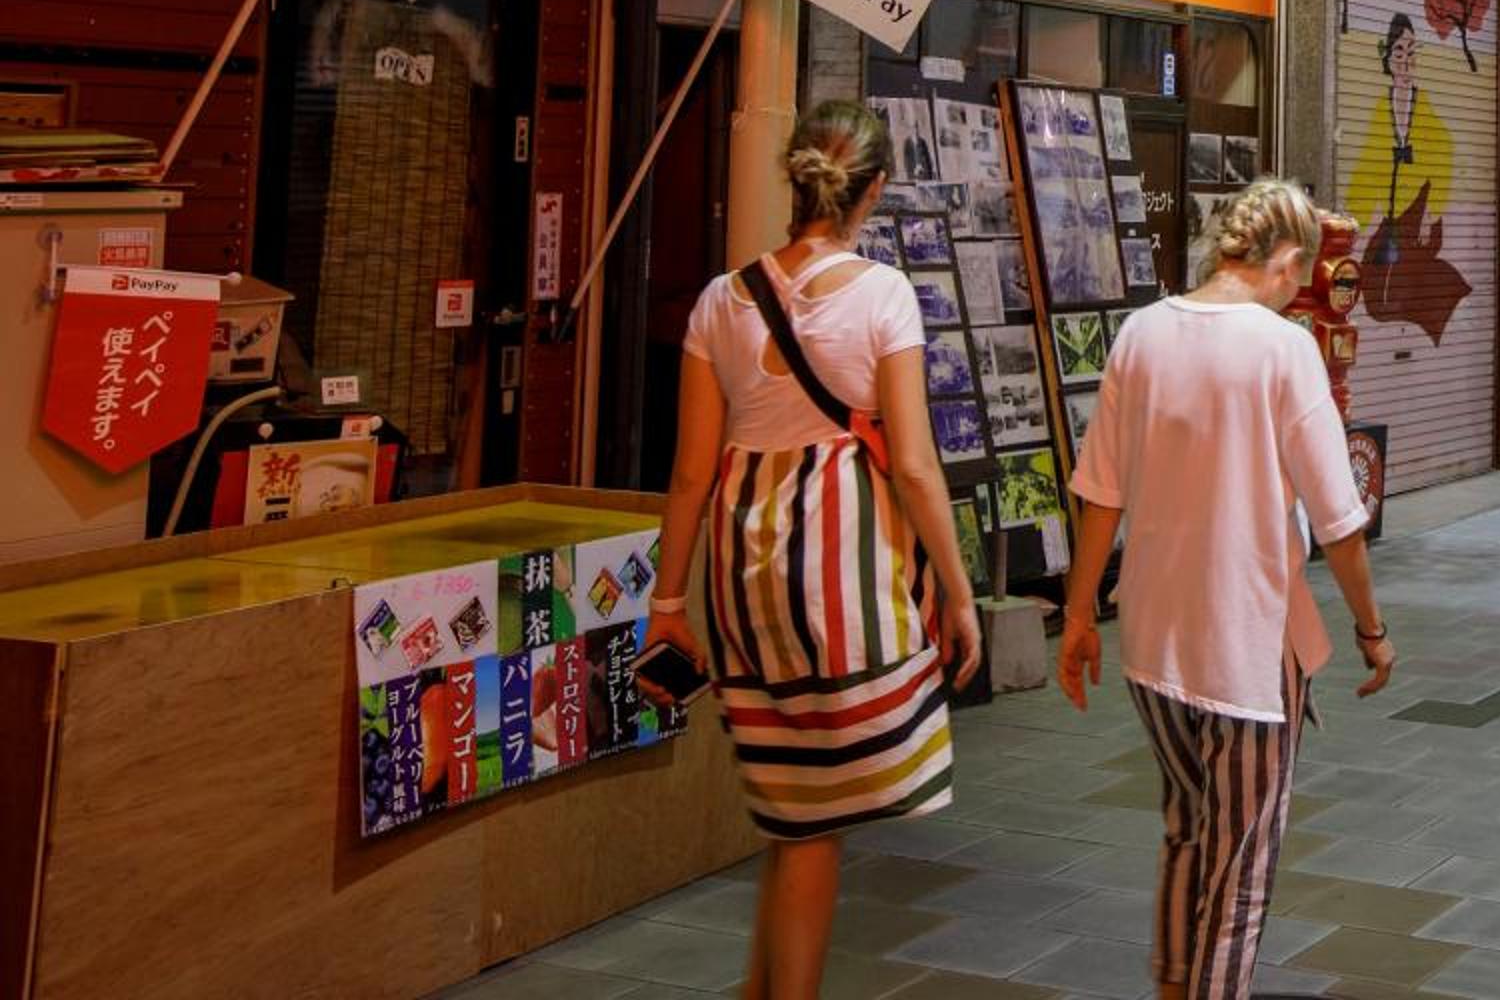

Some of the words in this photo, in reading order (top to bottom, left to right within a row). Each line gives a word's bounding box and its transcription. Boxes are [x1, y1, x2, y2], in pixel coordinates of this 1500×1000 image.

[379, 53, 427, 82] OPEN
[1142, 190, 1175, 213] ジェクト
[131, 278, 179, 293] PayPay
[90, 327, 135, 450] 使えます。
[130, 310, 174, 417] ペイペイ
[524, 554, 553, 648] 抹茶
[403, 677, 424, 806] ブルーベリー
[450, 670, 475, 793] マンゴー
[502, 655, 530, 766] バニラ
[559, 644, 583, 758] ストロベリー
[606, 635, 624, 743] チョコレート
